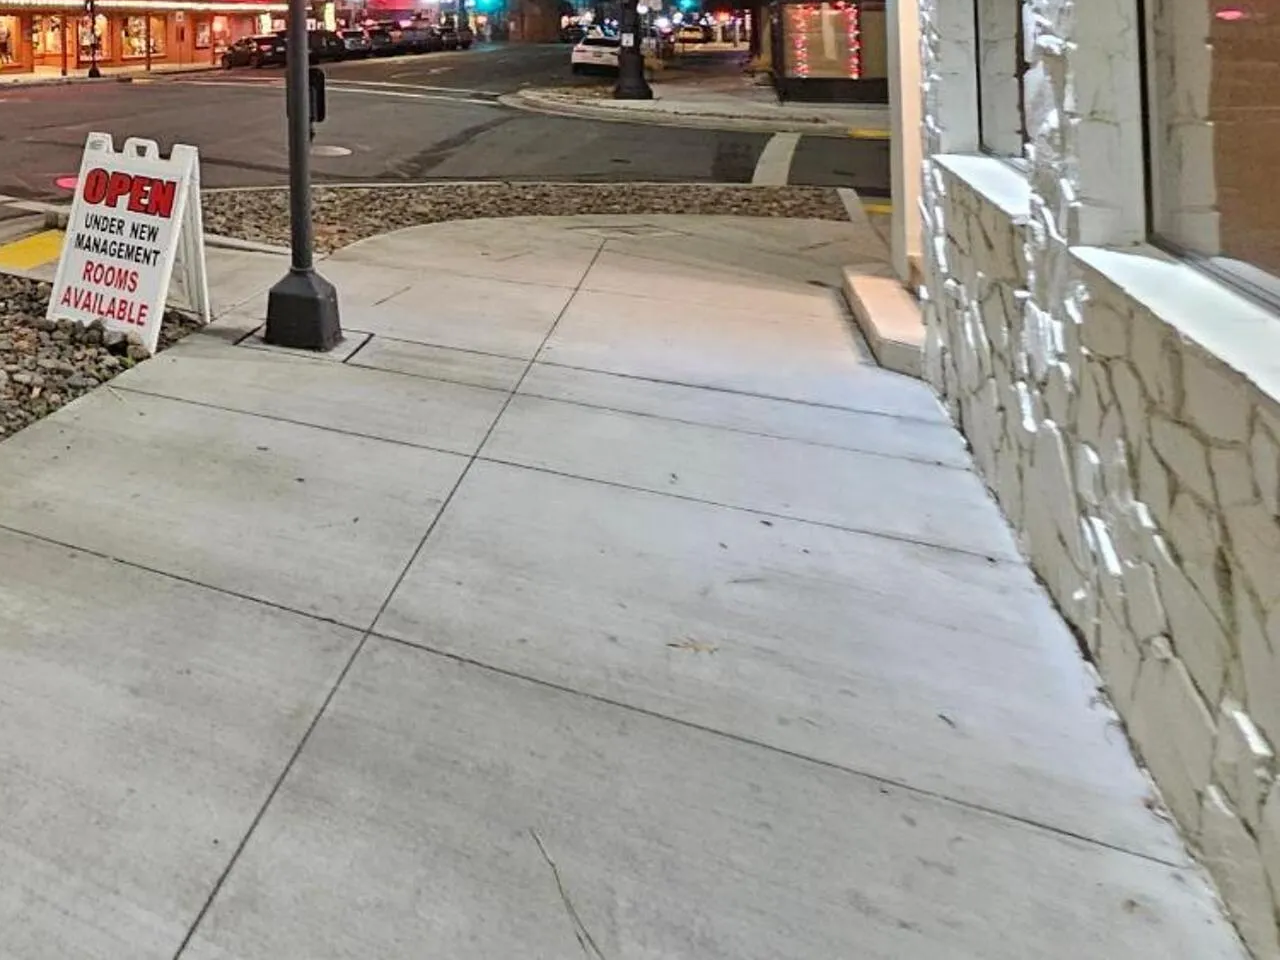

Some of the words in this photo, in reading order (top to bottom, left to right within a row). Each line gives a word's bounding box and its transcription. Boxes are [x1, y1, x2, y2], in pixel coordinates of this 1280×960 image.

[82, 167, 177, 219] OPEN
[84, 213, 124, 237] UNDER
[130, 222, 160, 243] NEW
[74, 233, 161, 267] MANAGEMENT
[82, 260, 140, 293] ROOMS
[61, 286, 149, 326] AVAILABLE
